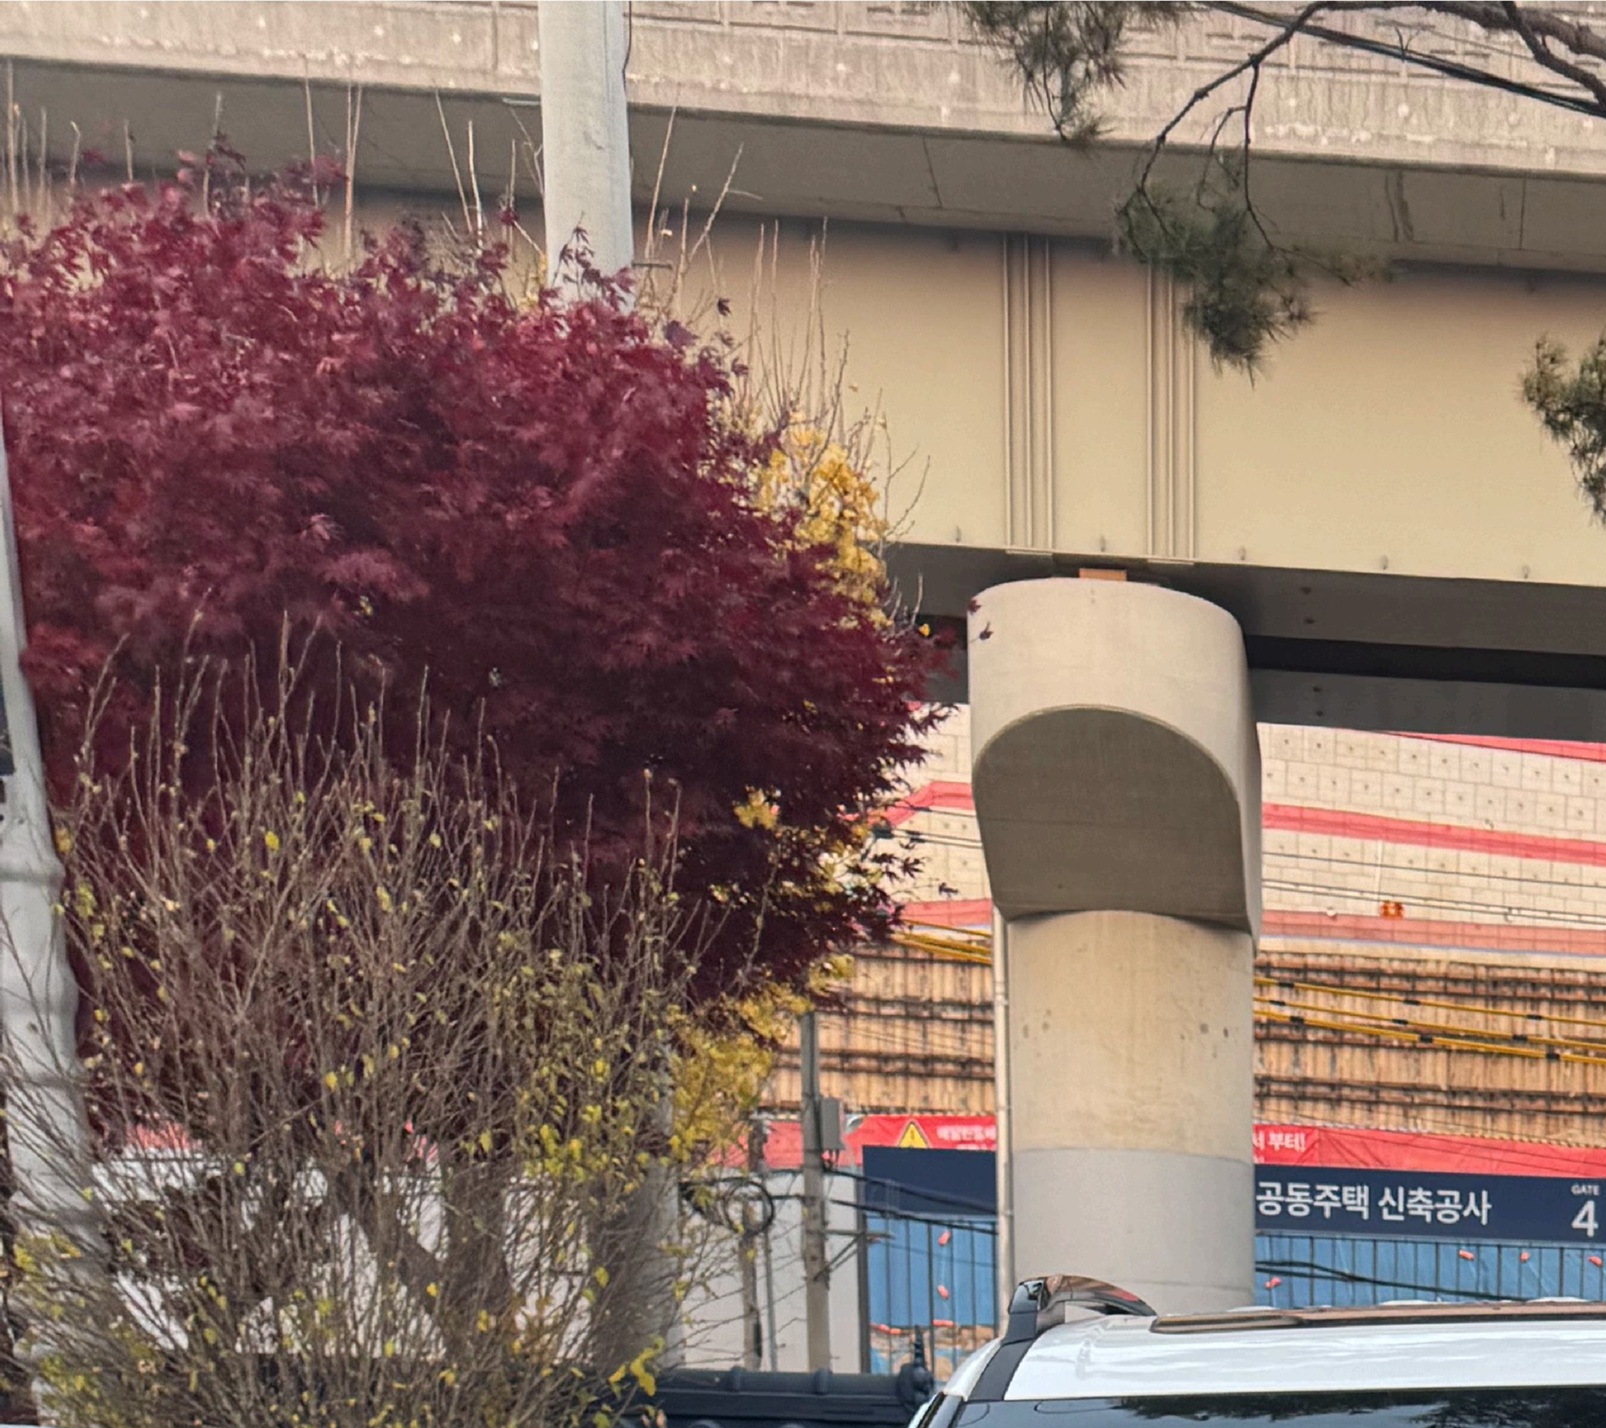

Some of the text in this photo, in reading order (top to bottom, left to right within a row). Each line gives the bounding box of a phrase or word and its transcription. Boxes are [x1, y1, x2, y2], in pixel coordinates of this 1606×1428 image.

[1267, 1130, 1306, 1153] 부터!
[1255, 1181, 1492, 1226] 공동주택 신축공사
[1571, 1185, 1600, 1196] GATE
[1571, 1200, 1599, 1238] 4
